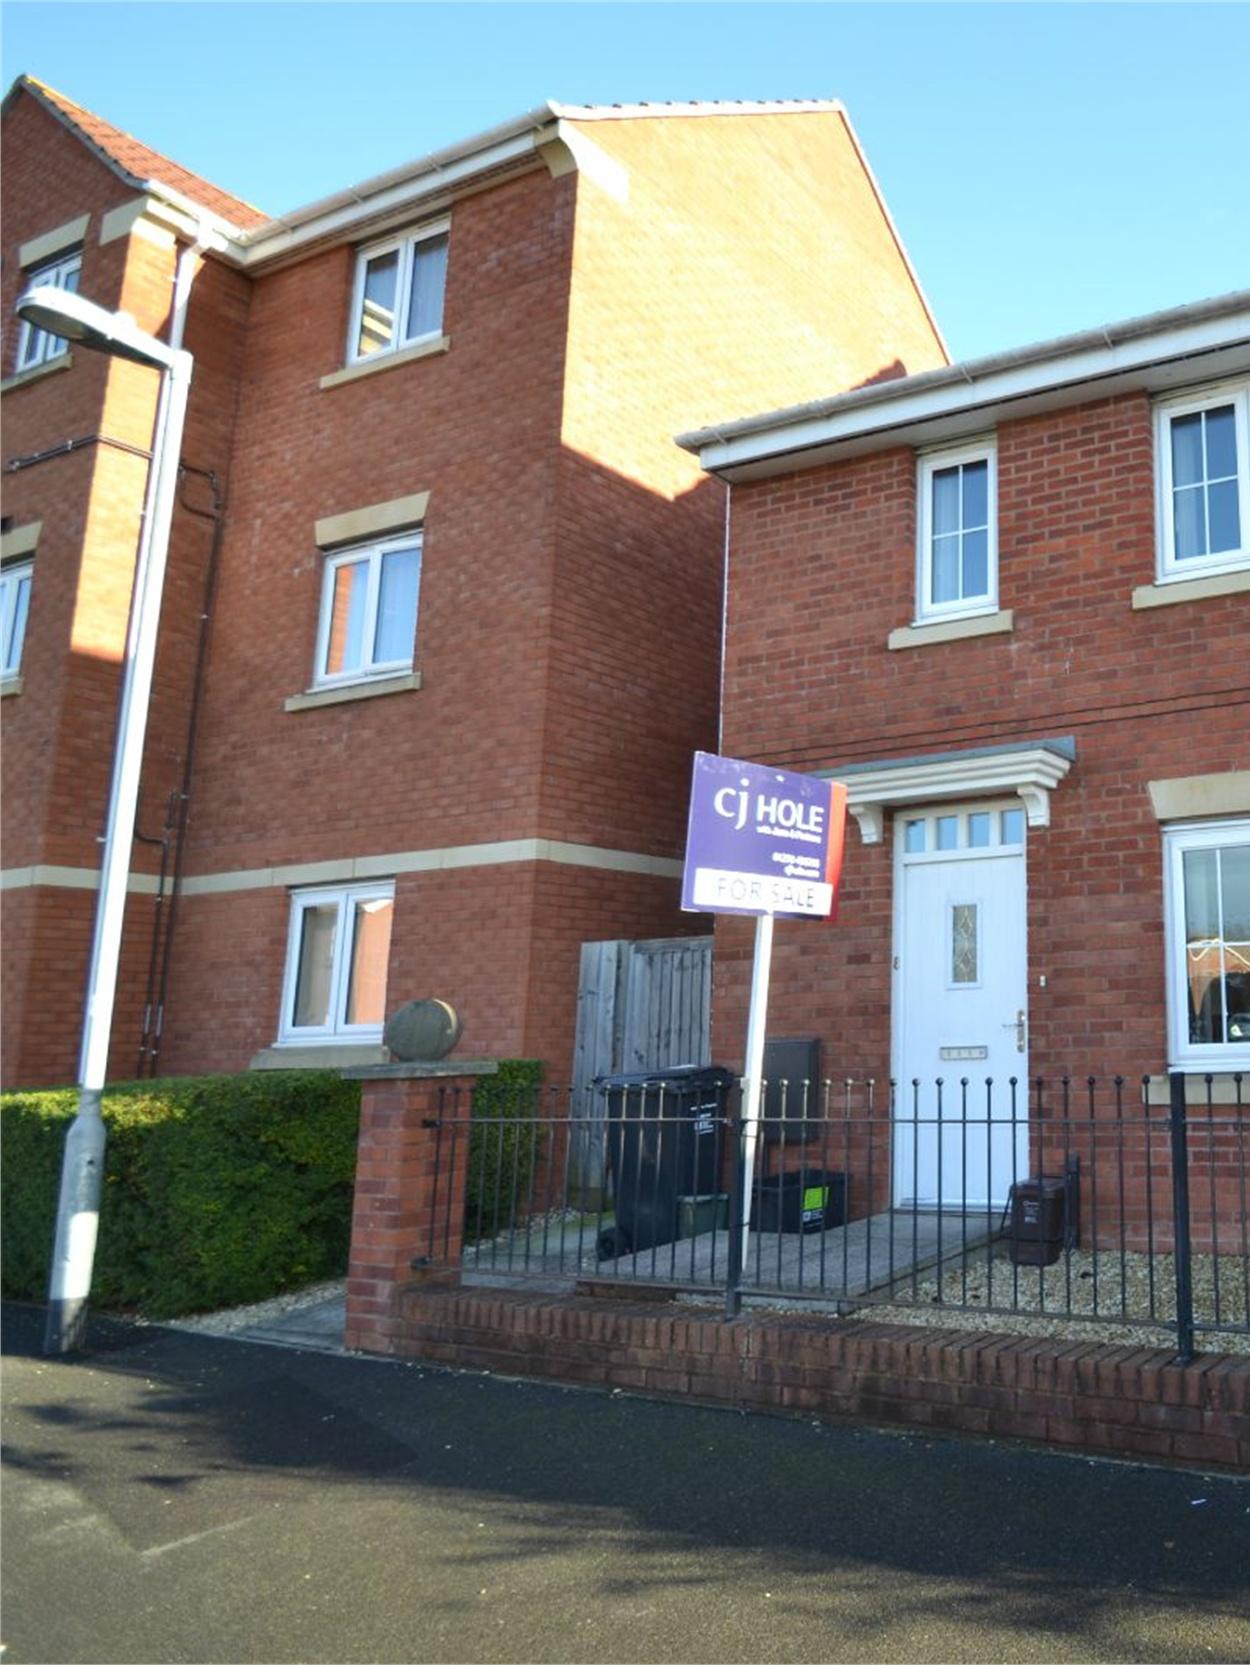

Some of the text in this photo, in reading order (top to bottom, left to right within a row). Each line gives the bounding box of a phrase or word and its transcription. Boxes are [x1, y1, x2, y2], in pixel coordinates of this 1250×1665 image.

[756, 794, 824, 833] HOLE
[718, 877, 815, 908] FOR SALE
